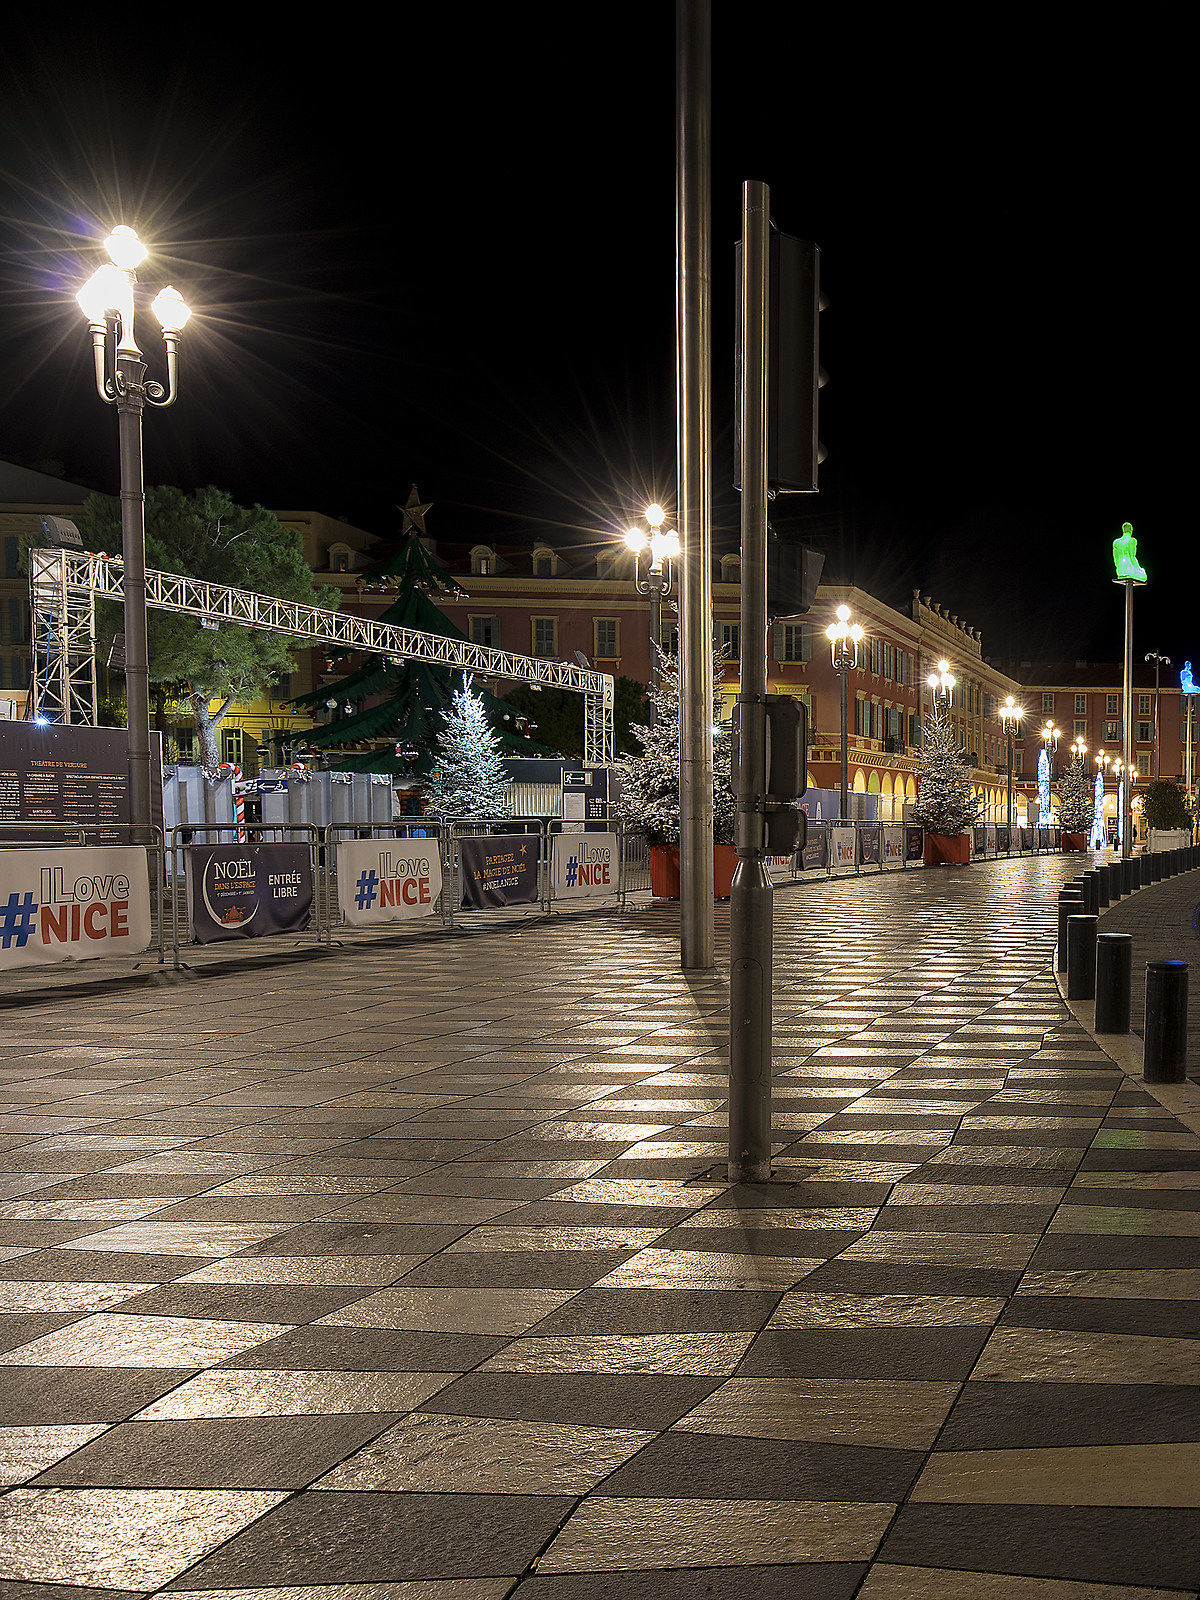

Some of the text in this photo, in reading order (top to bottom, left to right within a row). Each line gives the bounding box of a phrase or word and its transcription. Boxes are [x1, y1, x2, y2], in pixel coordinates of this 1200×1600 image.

[485, 853, 515, 866] PARTAGEZ
[214, 858, 256, 880] NOËL
[473, 870, 482, 880] LA
[483, 866, 502, 879] MAGIE
[502, 865, 511, 876] DE
[268, 869, 302, 886] ENTRÉE
[214, 882, 230, 891] DANS
[273, 886, 298, 899] LIBRE
